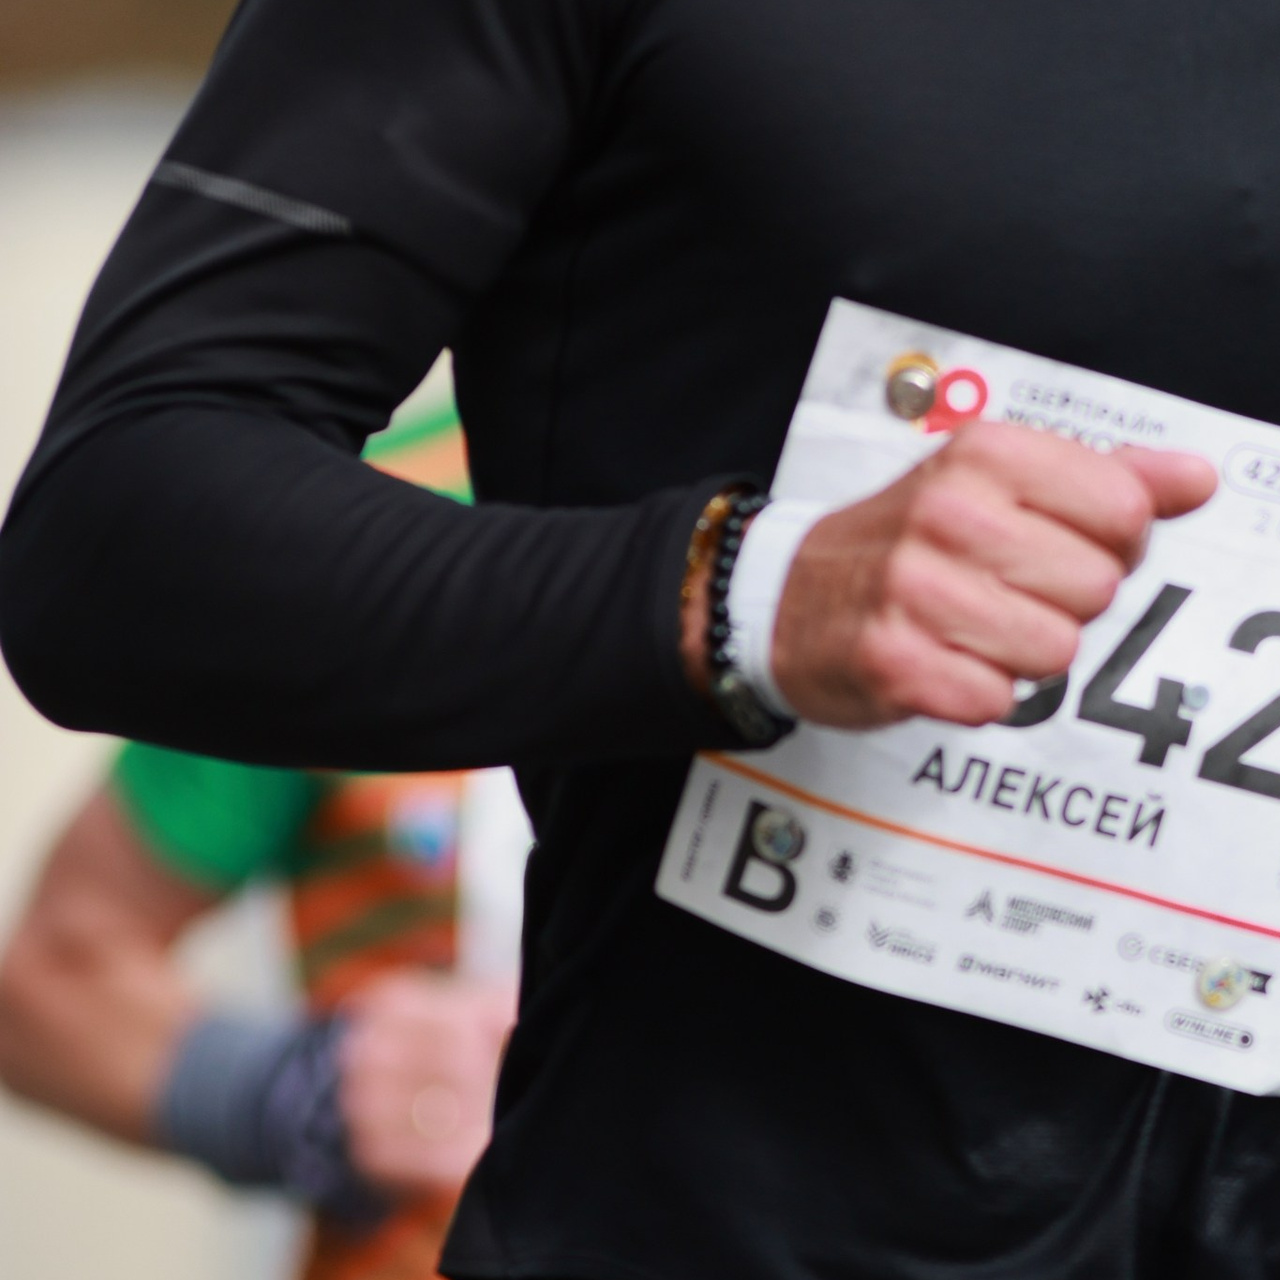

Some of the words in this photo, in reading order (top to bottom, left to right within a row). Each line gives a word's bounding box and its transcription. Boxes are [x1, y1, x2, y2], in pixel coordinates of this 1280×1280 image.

[1003, 406, 1128, 455] МОСКО
[1010, 379, 1166, 437] СБЕРПРАЙМ
[911, 745, 1166, 847] АЛЕКСЕЙ
